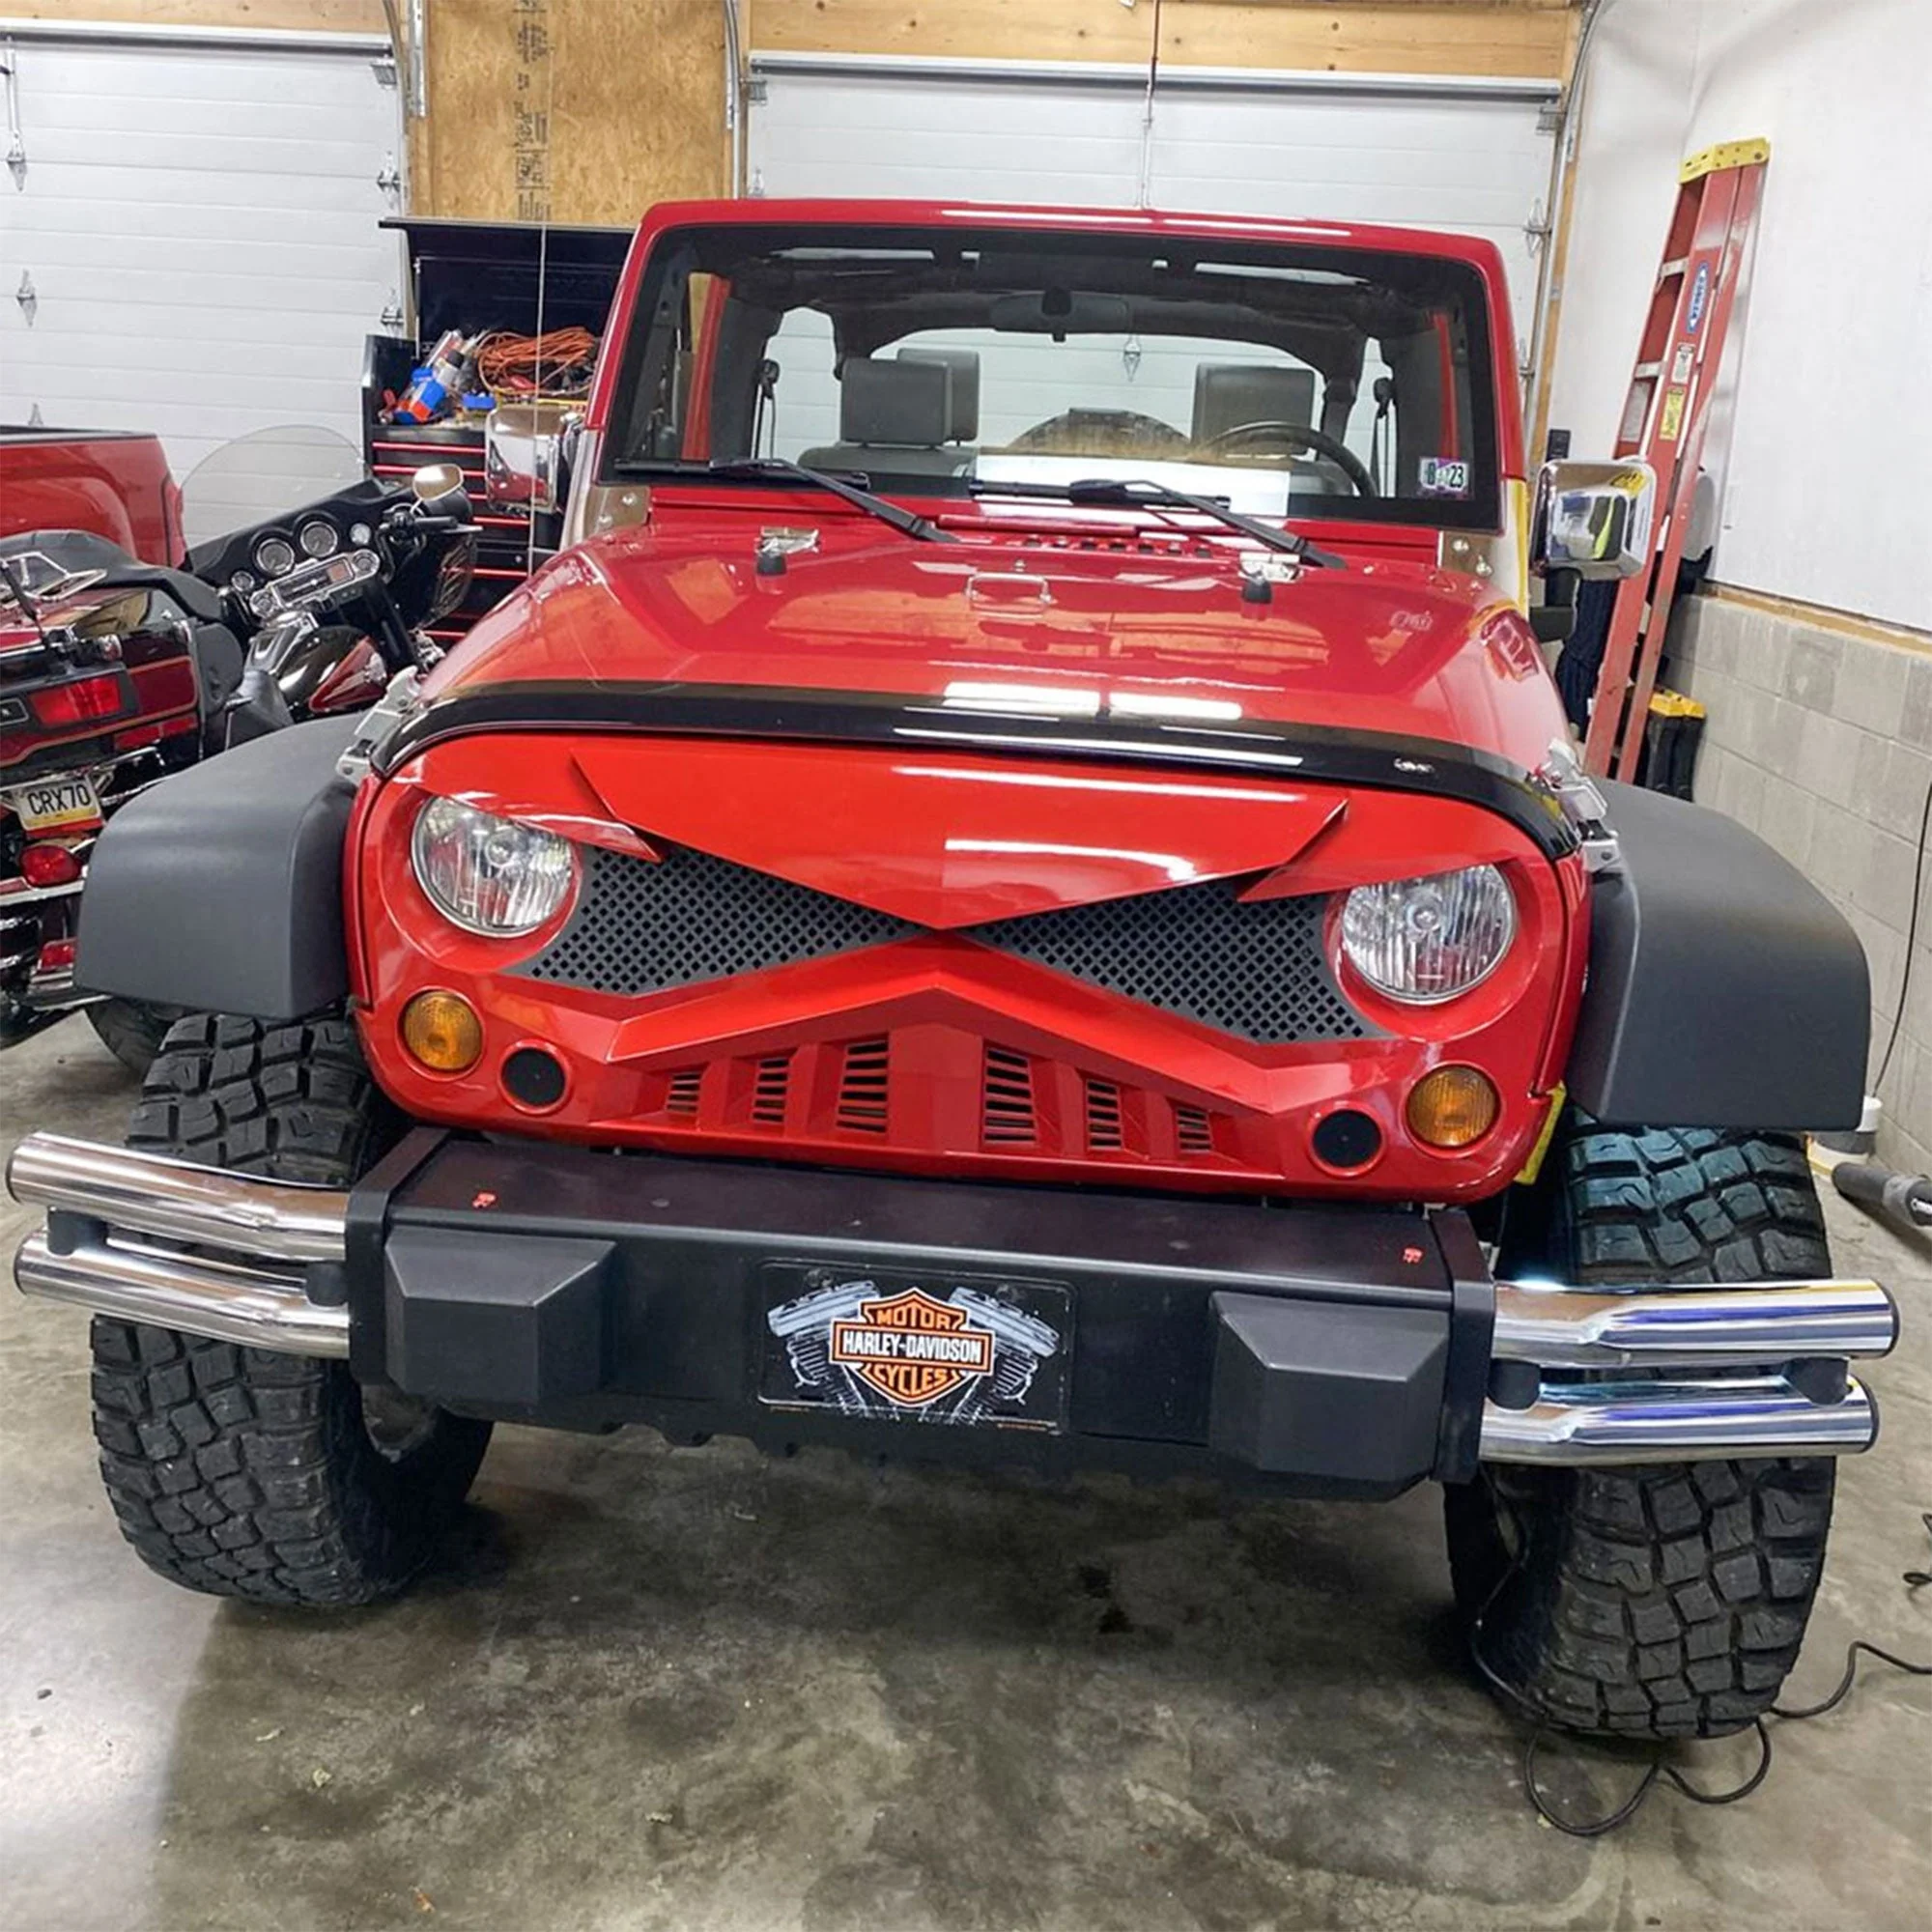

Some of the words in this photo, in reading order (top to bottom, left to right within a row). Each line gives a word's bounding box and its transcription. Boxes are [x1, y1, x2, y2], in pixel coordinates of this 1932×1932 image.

[1450, 464, 1464, 489] 23
[27, 784, 91, 815] CRX70
[877, 1305, 951, 1328] MOTOR
[842, 1330, 981, 1364] HARLEY-DAVIDSON
[873, 1364, 948, 1396] CYCLES
